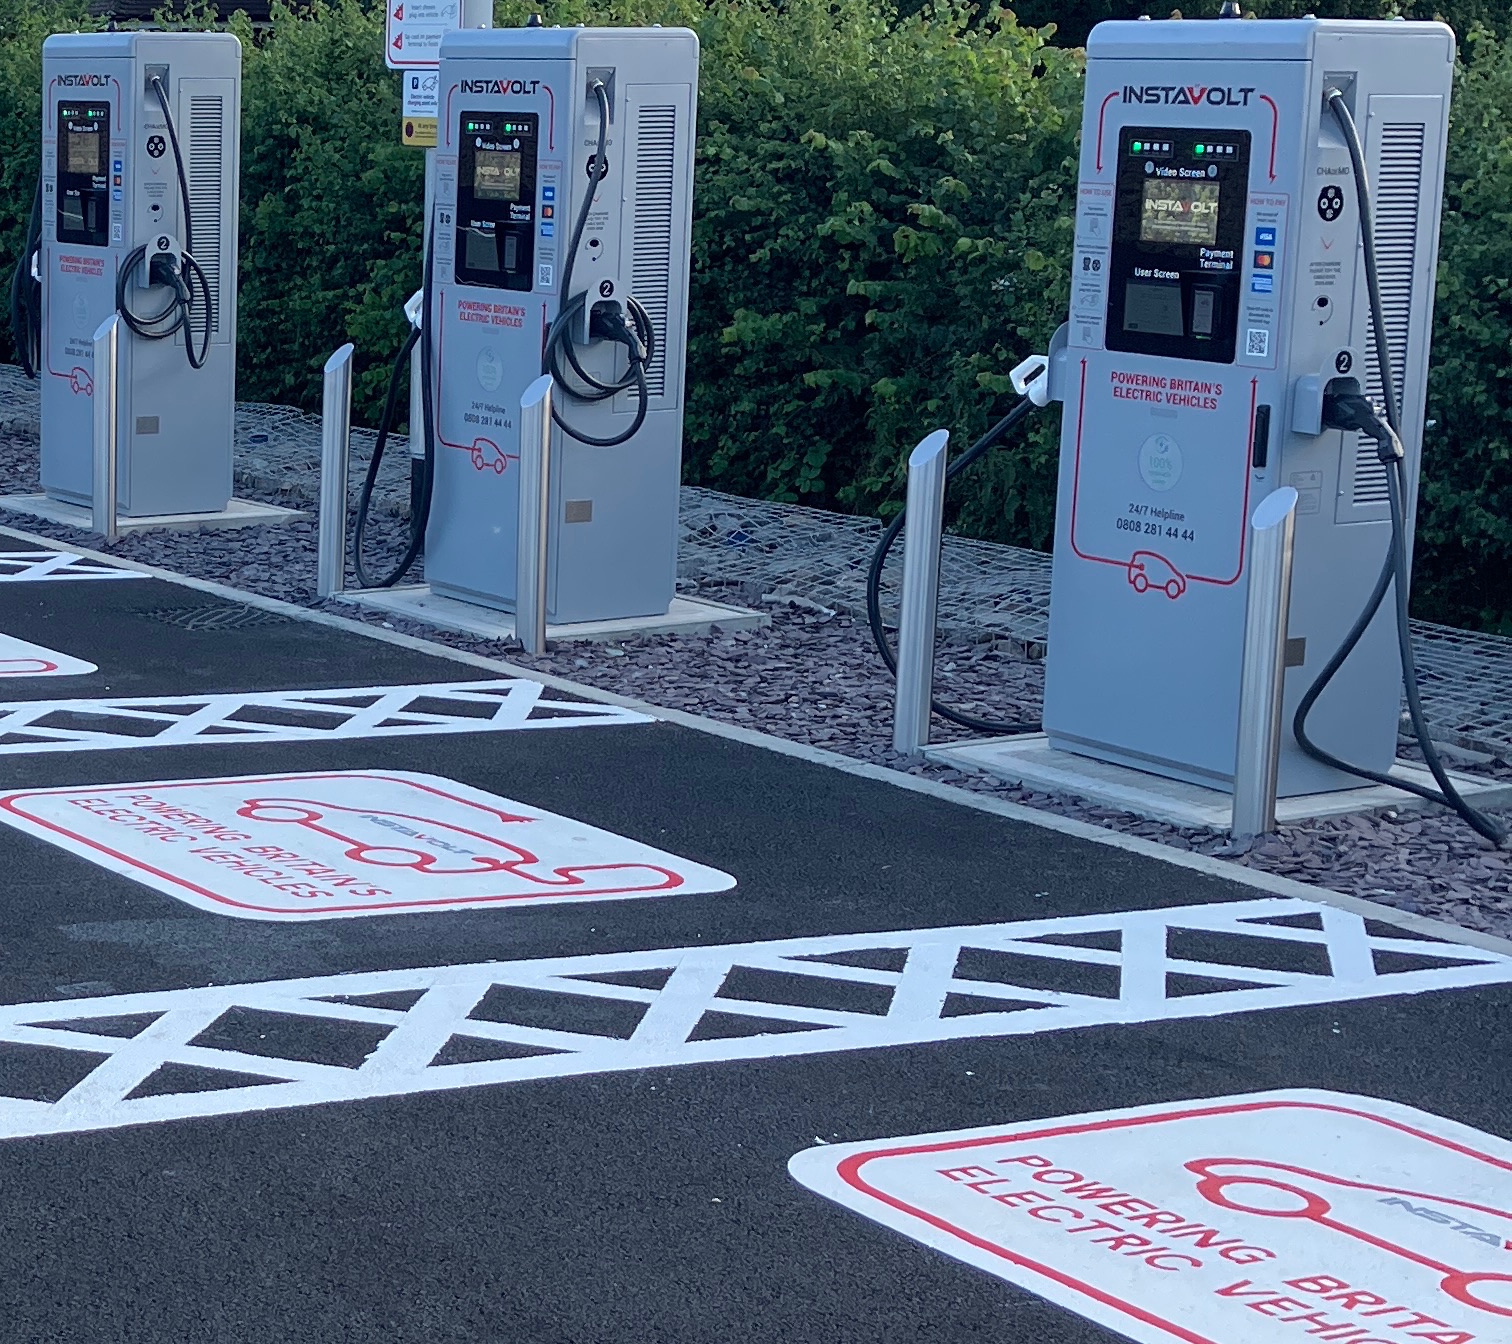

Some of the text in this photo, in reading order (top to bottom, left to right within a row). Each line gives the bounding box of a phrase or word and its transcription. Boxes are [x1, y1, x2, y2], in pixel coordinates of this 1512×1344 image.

[57, 74, 111, 87] INSTAVOLT
[461, 79, 540, 96] INSTAVOLT
[1122, 84, 1256, 107] INSTAVOLT
[1155, 166, 1206, 178] Video Screen
[1145, 198, 1219, 214] INSTAVOLT
[159, 237, 167, 249] 2
[1199, 248, 1234, 260] Payment
[1199, 258, 1234, 270] Terminal
[1134, 267, 1180, 279] User Screen
[602, 283, 610, 296] 2
[458, 300, 525, 317] POWERING BRITAIN'S
[459, 311, 522, 328] ELECTRIC VEHICLES
[1339, 354, 1348, 371] 2
[1110, 371, 1222, 396] POWERING BRITAIN'S
[1113, 386, 1217, 410] ELECTRIC VEHICLES
[494, 418, 502, 428] 44
[503, 419, 511, 429] 44
[1128, 503, 1185, 522] 24/7 Helpline
[1116, 517, 1195, 542] 0808 281 44 44
[67, 798, 335, 898] ELECTRIC VEHICLES
[114, 794, 393, 897] POWERING BRITAIN'S
[935, 1164, 1204, 1271] ELECTRIC
[995, 1155, 1277, 1264] POWERING
[1376, 1197, 1512, 1250] INSTA
